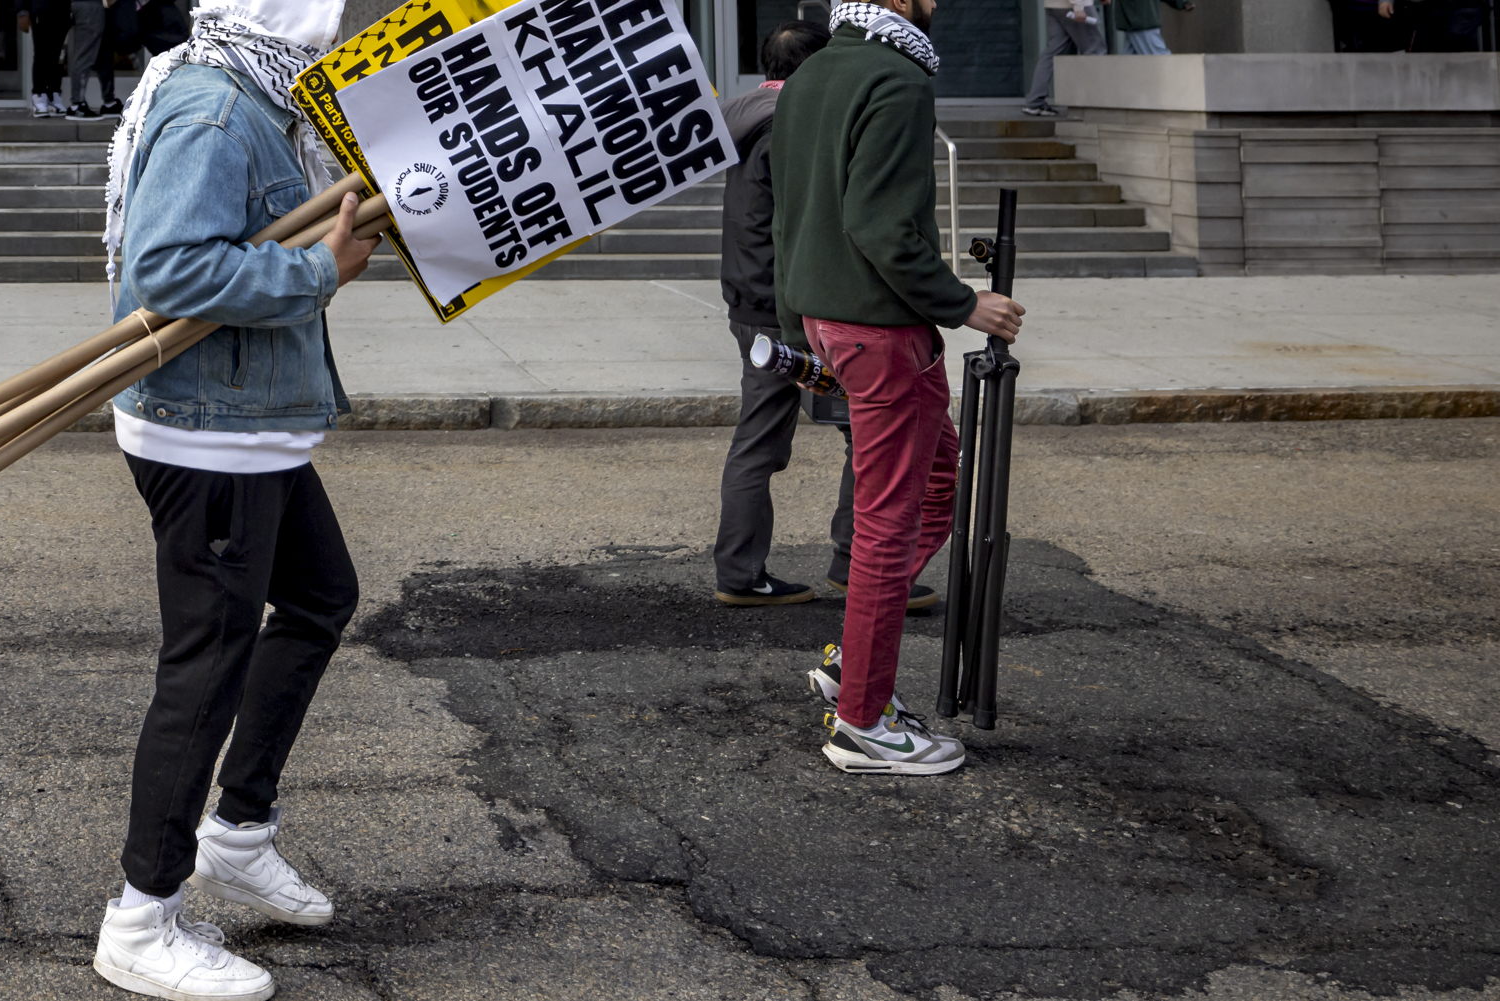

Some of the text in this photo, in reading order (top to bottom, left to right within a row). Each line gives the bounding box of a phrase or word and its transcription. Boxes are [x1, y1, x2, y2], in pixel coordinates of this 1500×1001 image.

[318, 92, 345, 127] Party
[340, 125, 357, 144] for
[441, 32, 573, 250] HANDS OFF
[504, 7, 603, 227] KHALIL
[395, 167, 412, 185] FOR
[408, 56, 459, 125] OUR
[438, 122, 528, 269] STUDENTS
[413, 162, 449, 210] SHUT IT DOWN!
[394, 186, 432, 216] PALESTINE
